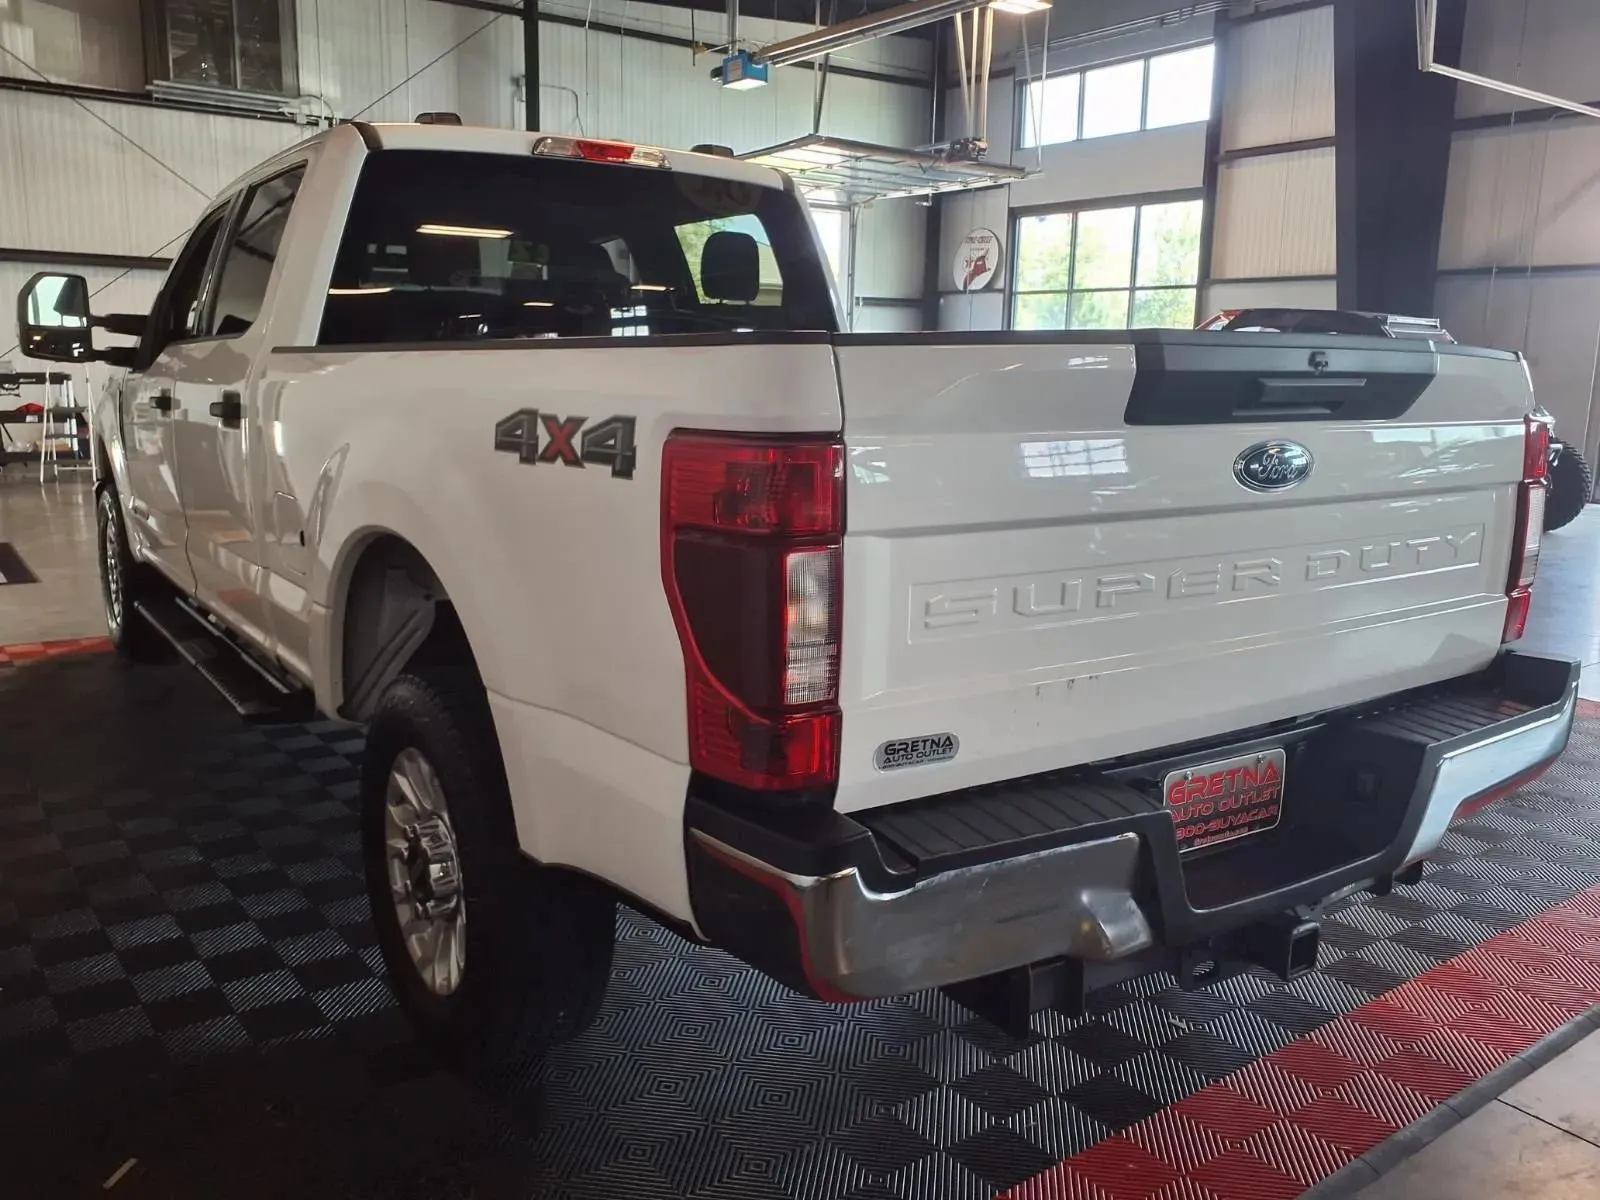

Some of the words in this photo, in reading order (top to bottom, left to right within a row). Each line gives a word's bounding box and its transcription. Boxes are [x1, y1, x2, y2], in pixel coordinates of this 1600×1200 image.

[1257, 452, 1299, 480] Ford
[923, 556, 1283, 629] SUPER
[1304, 531, 1477, 582] DUTY
[883, 753, 913, 763] AUTO
[916, 748, 952, 758] OUTLET
[884, 736, 953, 755] GRETNA
[1168, 762, 1280, 805] GRETNA
[1171, 804, 1214, 822] AUTO
[1218, 787, 1280, 811] OUTLET
